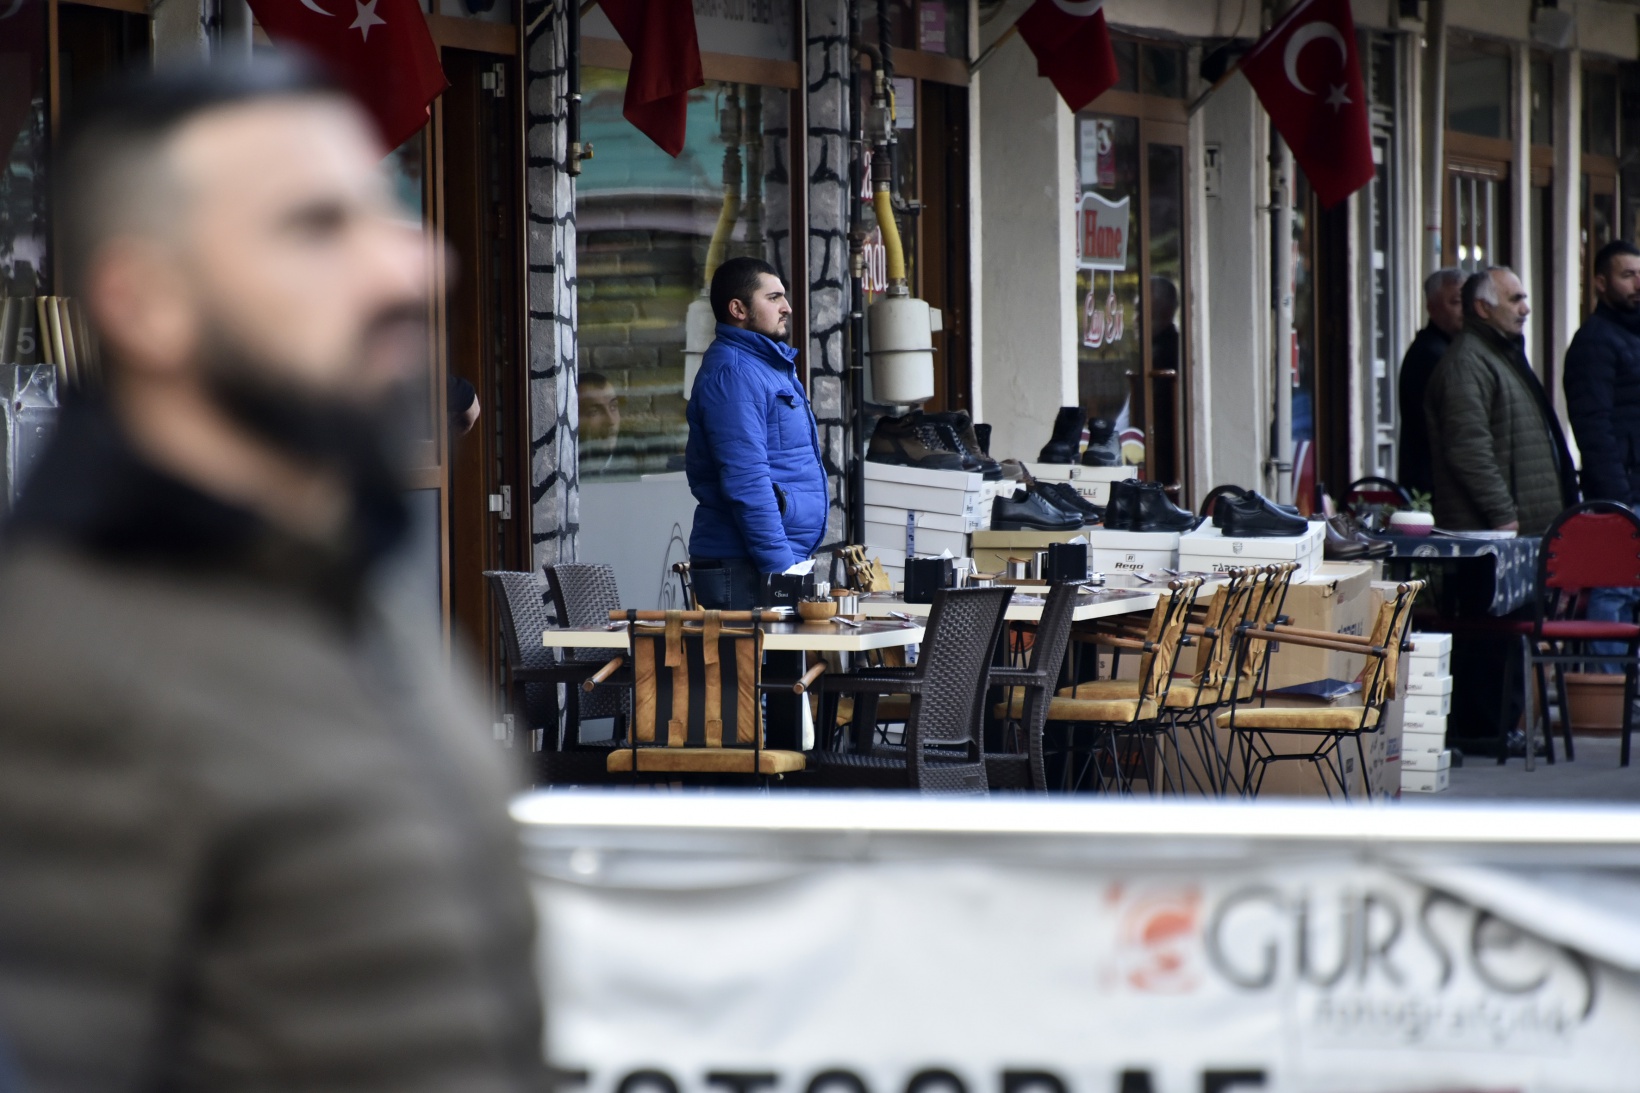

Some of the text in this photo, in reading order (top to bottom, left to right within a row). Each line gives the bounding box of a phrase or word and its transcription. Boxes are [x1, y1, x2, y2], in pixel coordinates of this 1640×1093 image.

[1084, 209, 1122, 259] Hane
[16, 327, 35, 355] 5
[1115, 562, 1144, 570] Rego
